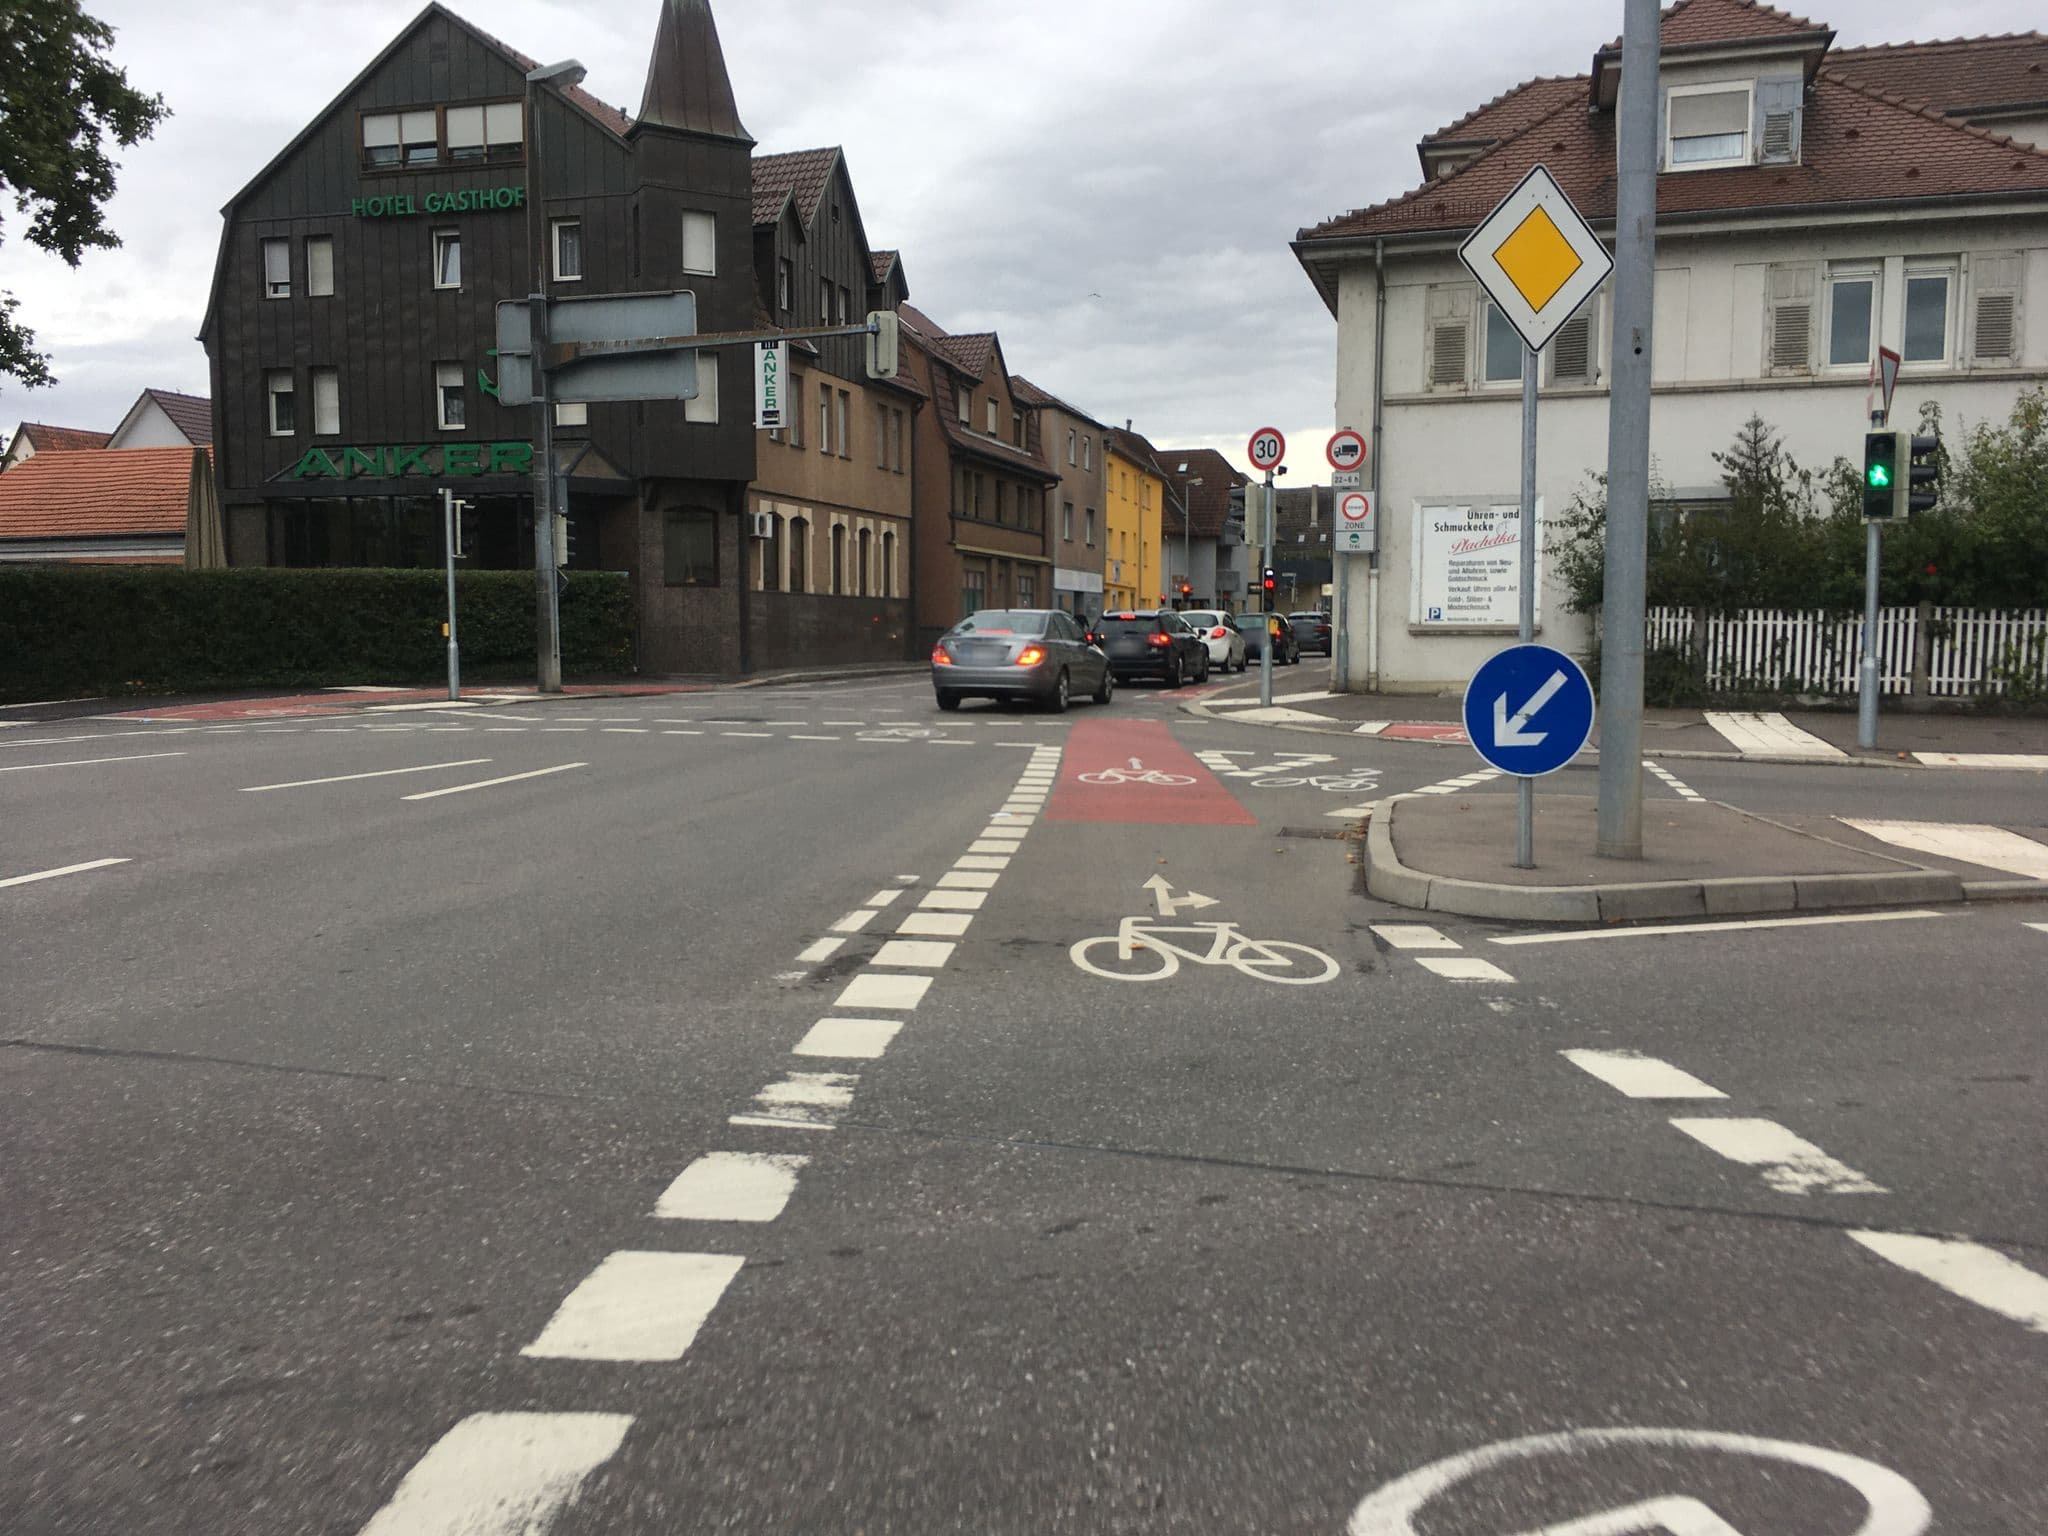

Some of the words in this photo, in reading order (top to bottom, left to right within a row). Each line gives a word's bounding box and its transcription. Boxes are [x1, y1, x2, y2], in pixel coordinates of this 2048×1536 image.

[352, 195, 416, 217] HOTEL
[425, 186, 524, 213] GASTHOF
[764, 350, 777, 409] ANKER
[294, 442, 534, 479] ANKER
[1256, 439, 1277, 459] 30
[1467, 510, 1499, 520] Uhren-
[1503, 508, 1520, 519] und
[1434, 521, 1494, 533] Schmuckecke
